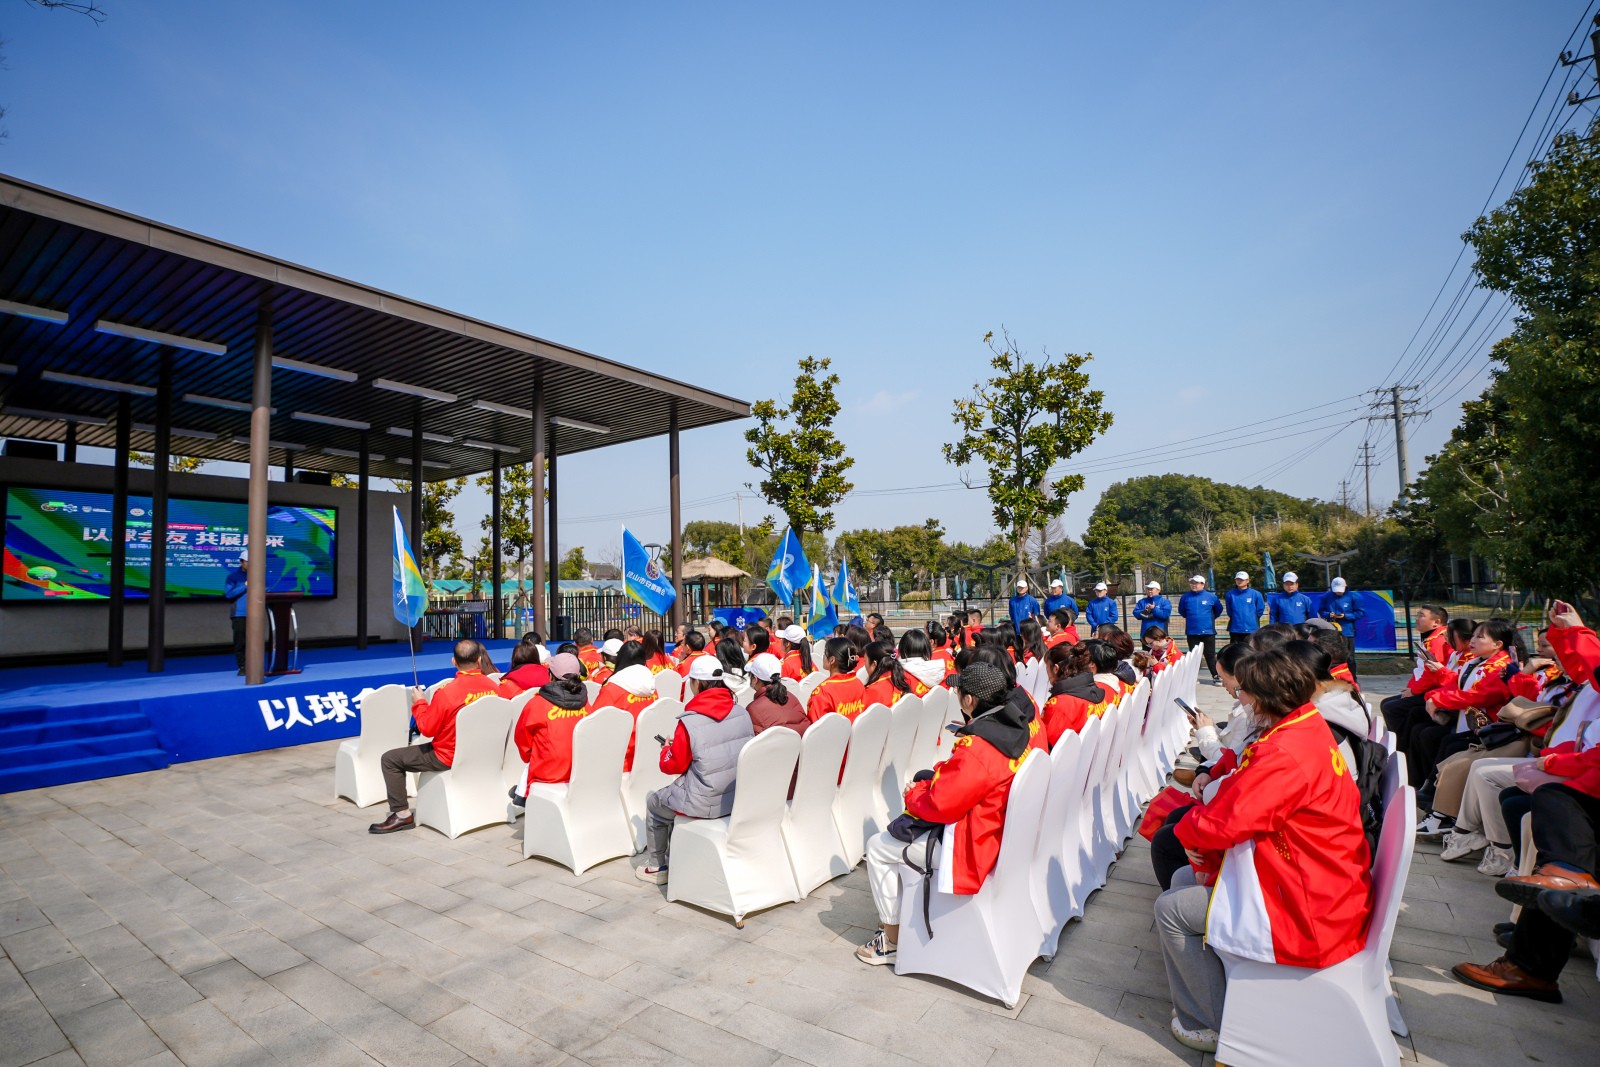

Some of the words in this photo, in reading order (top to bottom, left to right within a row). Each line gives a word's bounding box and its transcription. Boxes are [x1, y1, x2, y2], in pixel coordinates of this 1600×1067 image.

[195, 532, 284, 547] 共展采
[547, 706, 588, 720] CHINA
[837, 698, 865, 715] CHINA
